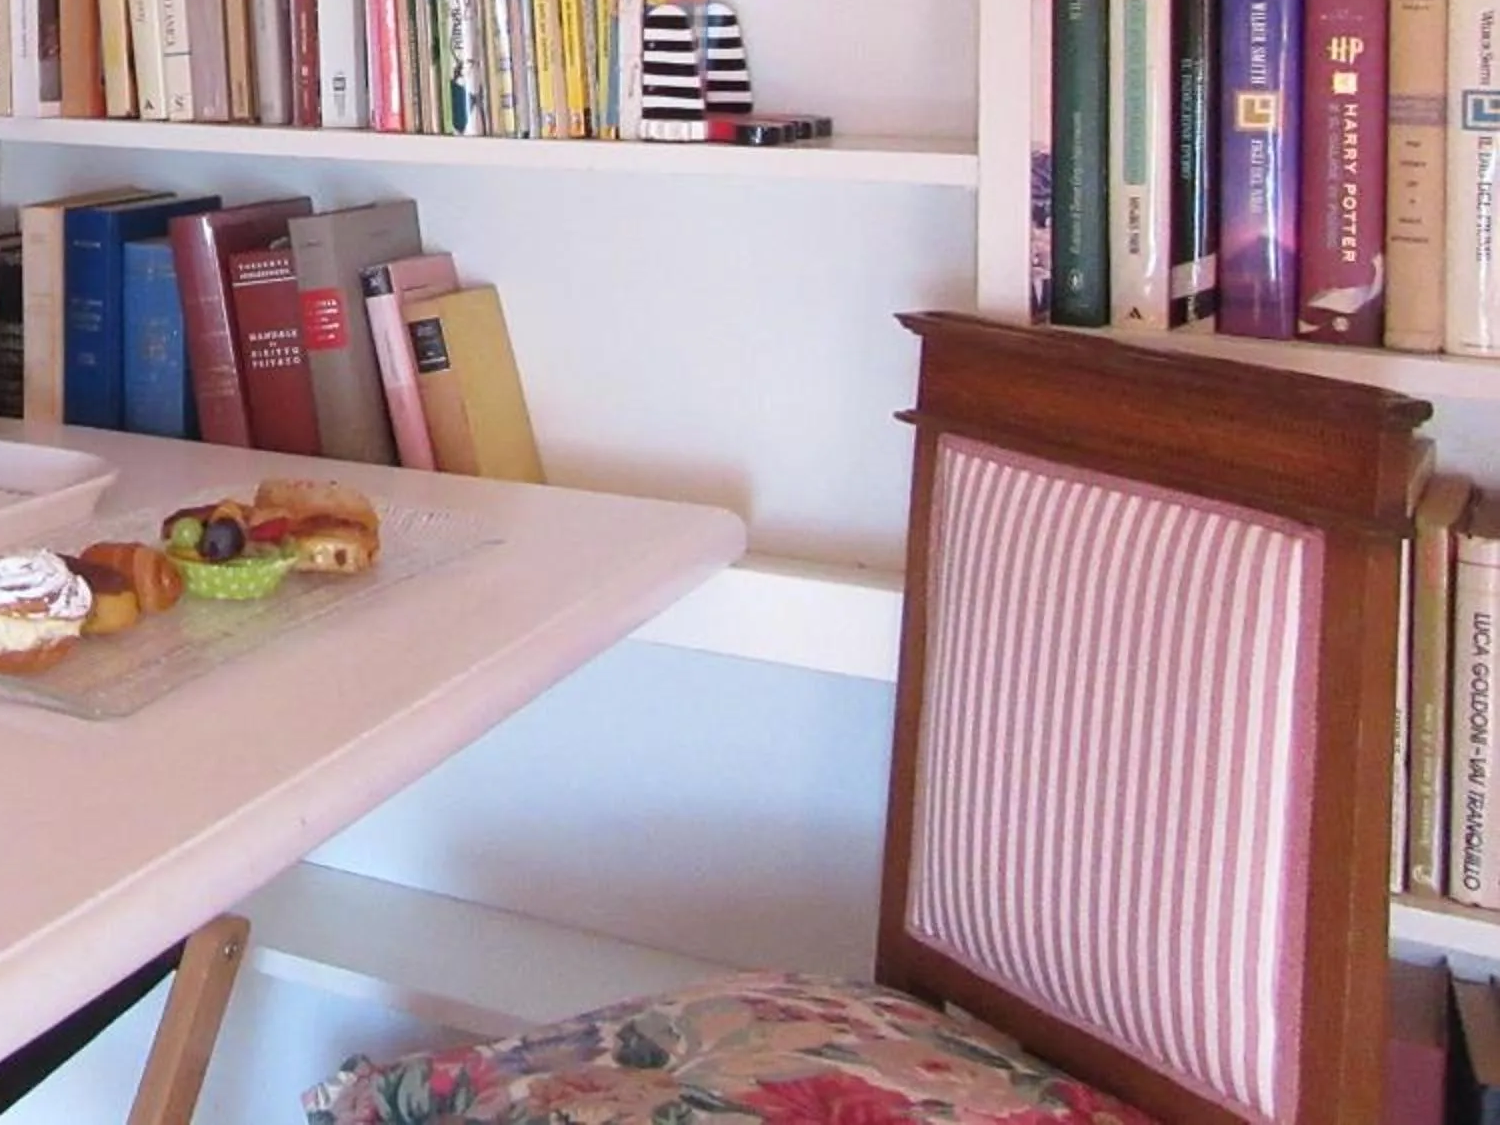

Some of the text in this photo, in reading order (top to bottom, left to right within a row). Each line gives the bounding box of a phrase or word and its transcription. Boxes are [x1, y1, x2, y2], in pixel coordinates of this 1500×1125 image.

[1250, 2, 1267, 85] WILBUR SMITH
[1479, 10, 1495, 85] WILBUR SMITH
[1341, 103, 1356, 263] HARRY POTTER
[1473, 612, 1491, 657] LUCA
[1469, 663, 1489, 744] GOLDONI
[1463, 789, 1484, 891] TRANQUILLO
